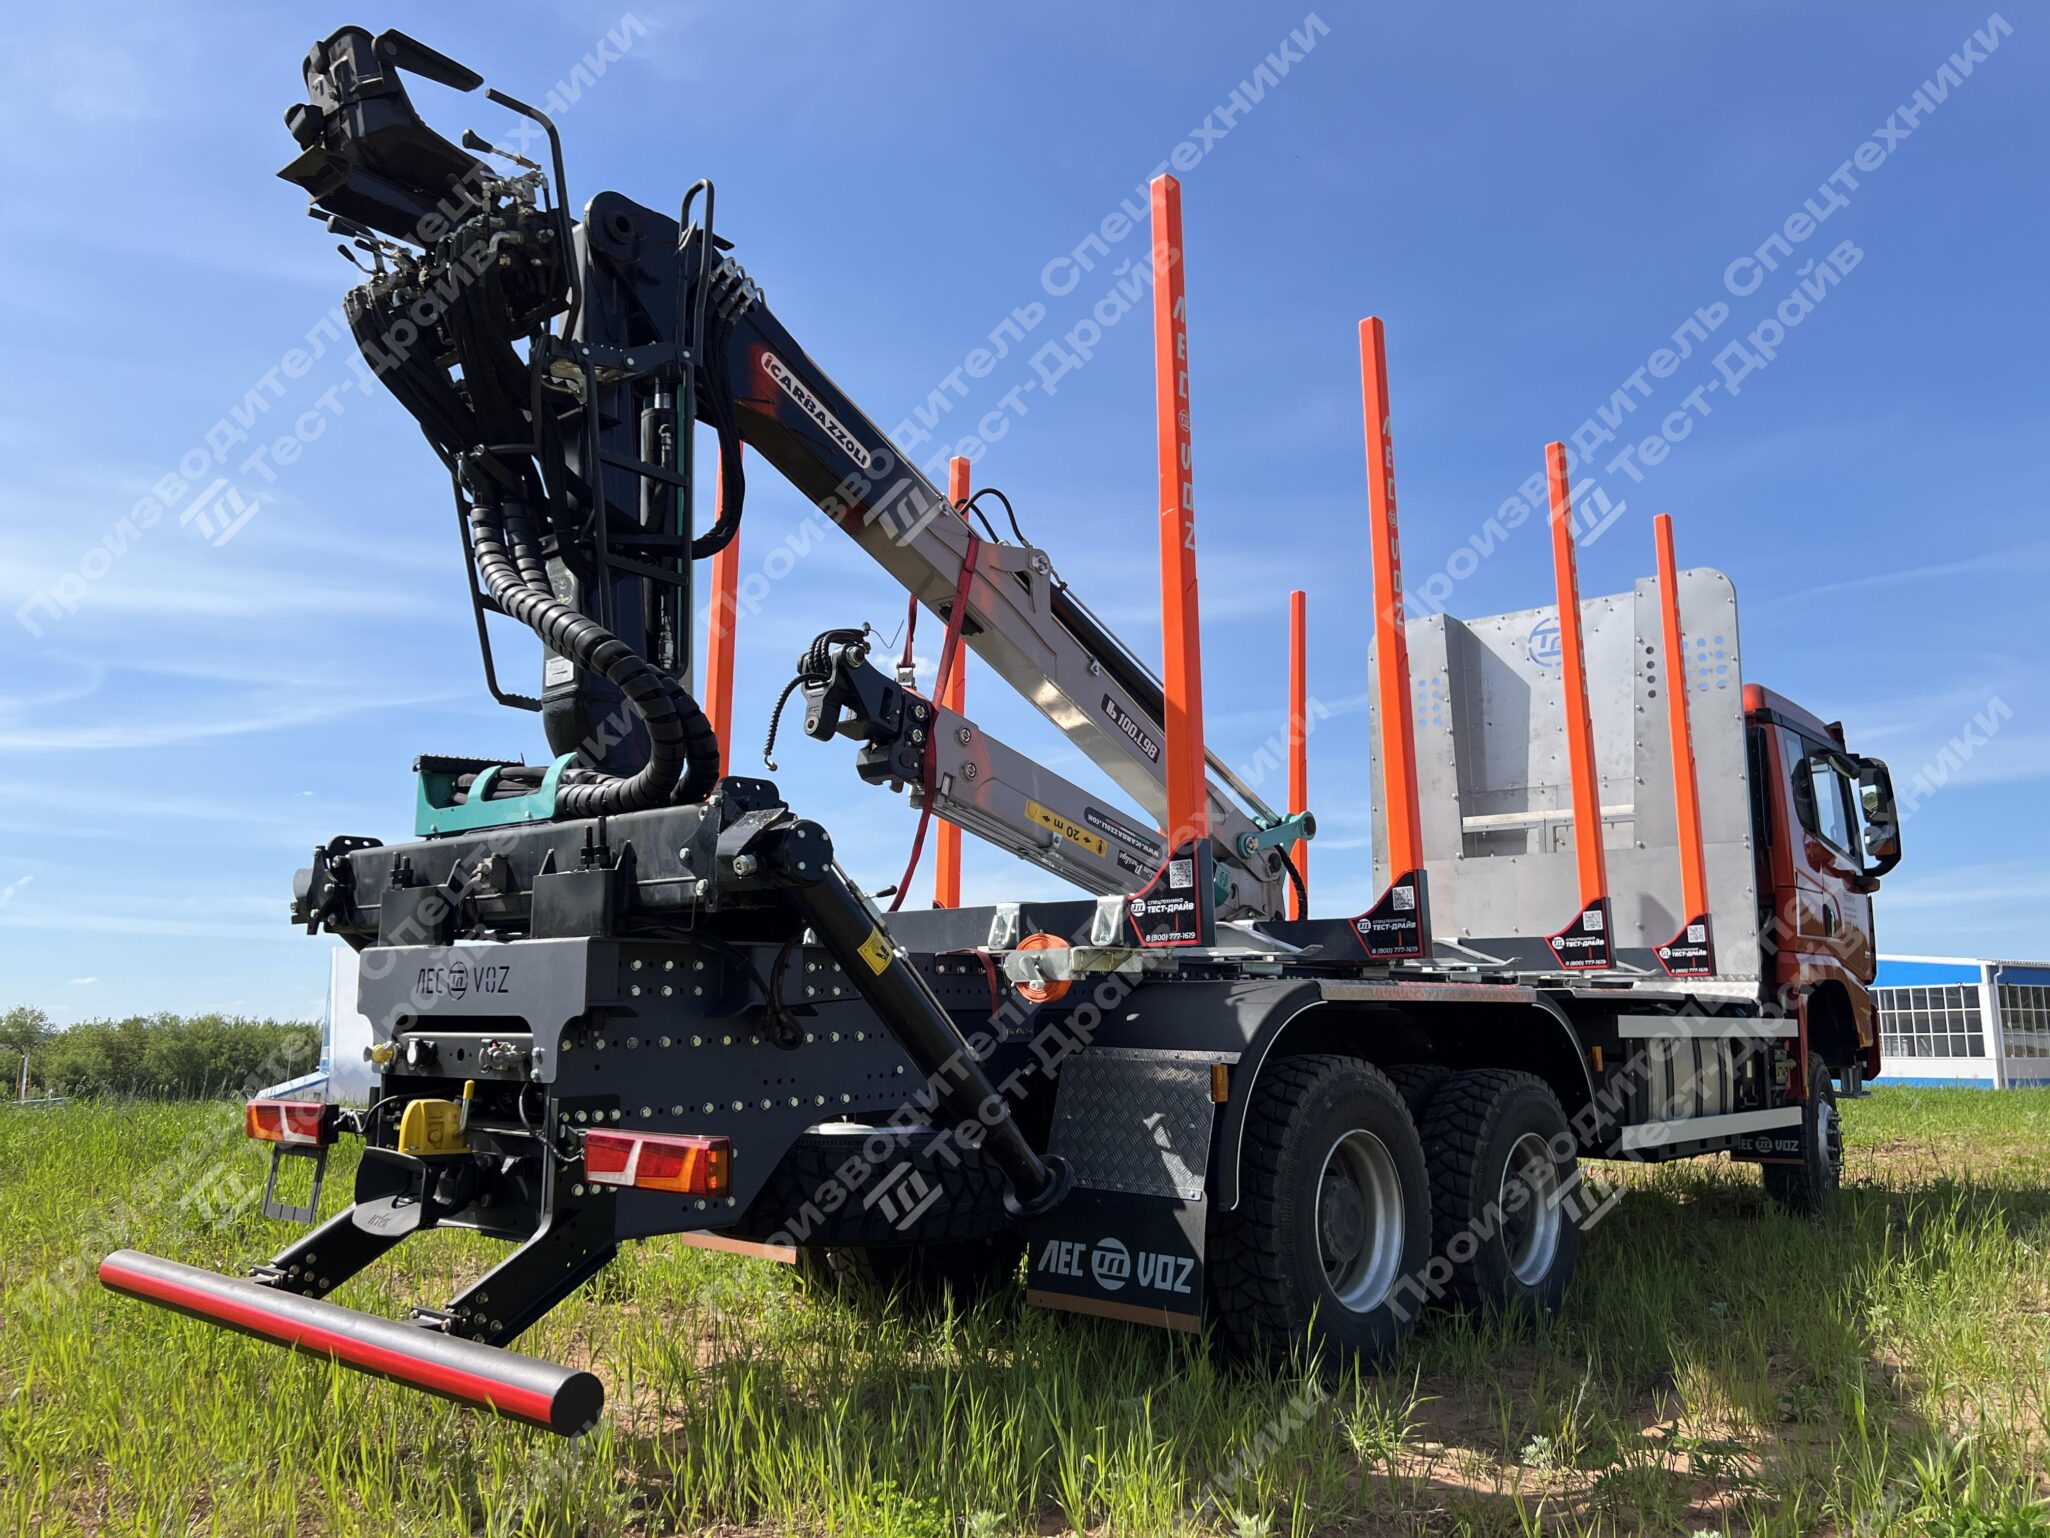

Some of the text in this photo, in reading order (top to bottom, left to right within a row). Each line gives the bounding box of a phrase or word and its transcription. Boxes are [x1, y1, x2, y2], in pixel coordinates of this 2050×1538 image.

[1053, 818, 1080, 842] 20 m
[1147, 901, 1194, 913] ТЕСТ-ДРАЙВ
[1373, 921, 1416, 931] ТЕСТ-ДРАЙВ
[1565, 938, 1605, 948] ТЕСТ-ДРАЙВ
[474, 966, 510, 993] VOZ
[1775, 1140, 1799, 1152] VOZ
[1038, 1239, 1087, 1277] ЛЕС
[1137, 1251, 1195, 1294] VOZ
